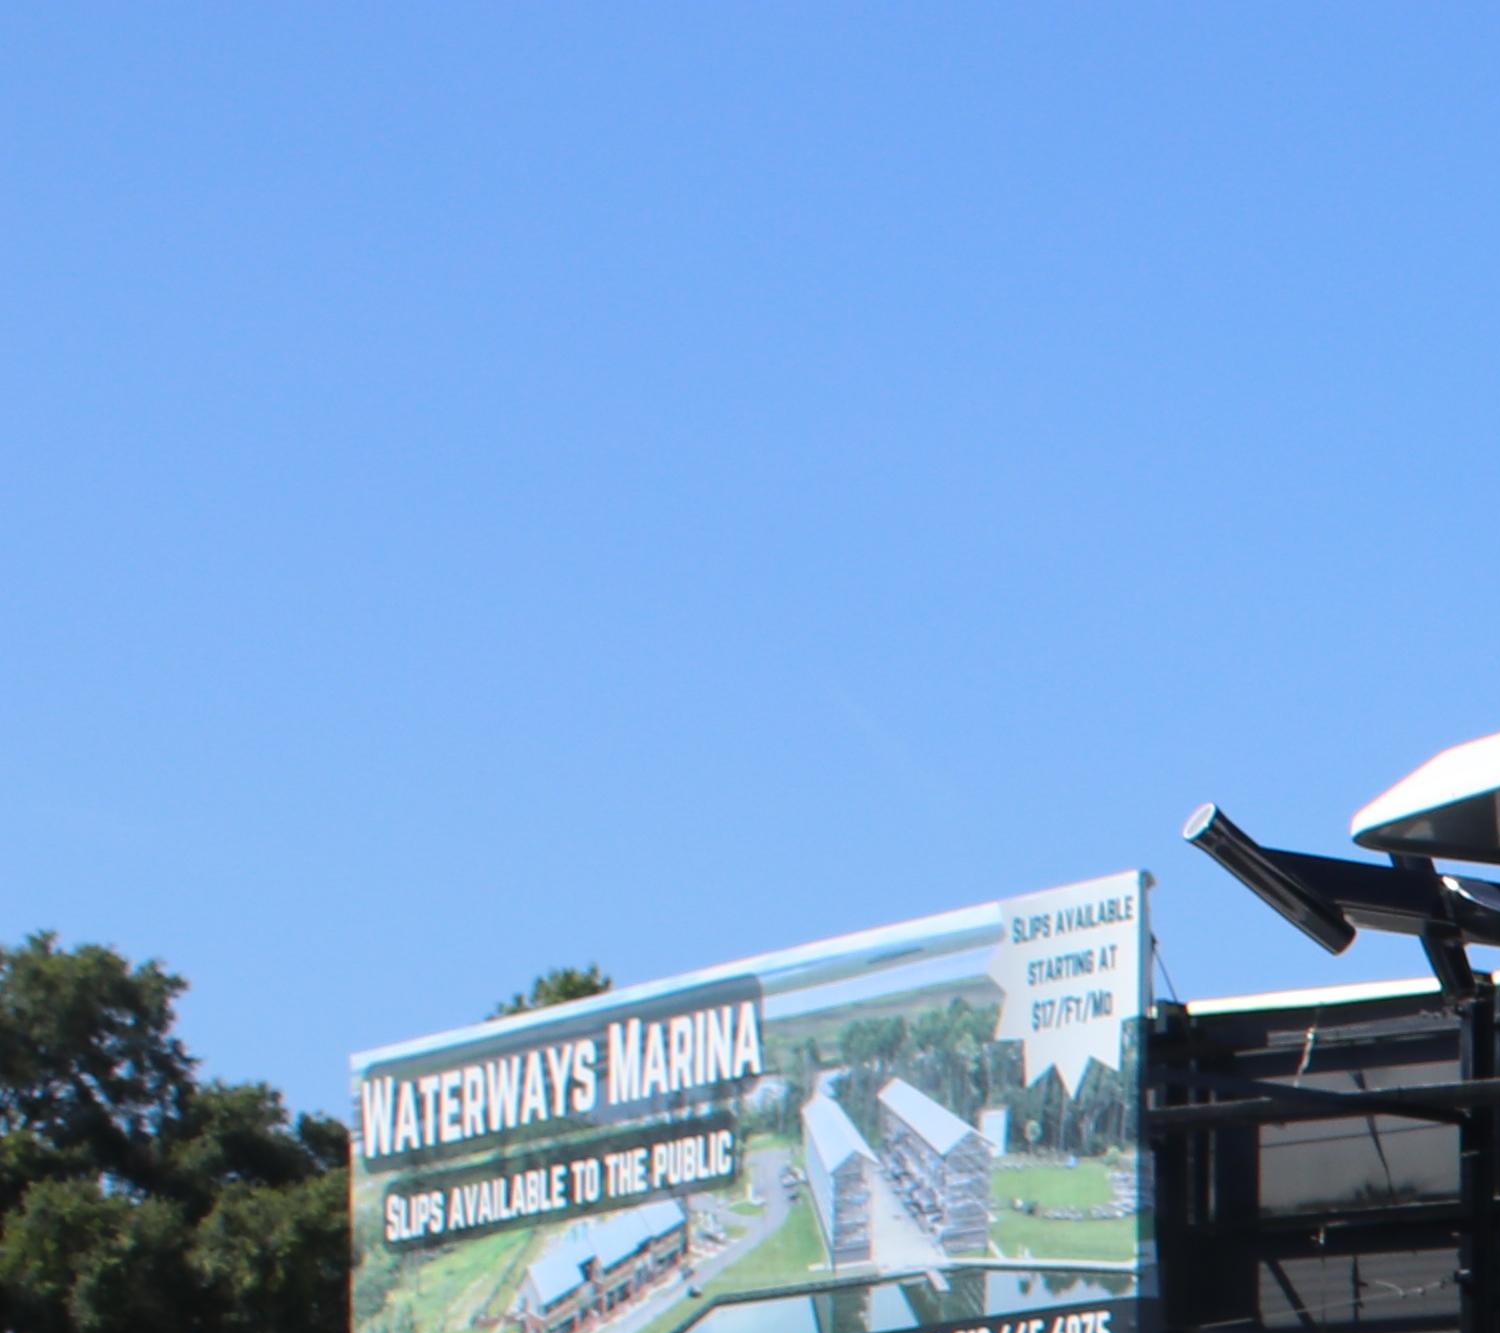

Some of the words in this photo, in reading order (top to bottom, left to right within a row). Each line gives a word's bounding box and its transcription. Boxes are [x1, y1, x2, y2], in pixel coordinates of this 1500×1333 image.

[1012, 912, 1051, 944] SLIPS
[1055, 895, 1134, 935] AVAILABLE
[1027, 949, 1094, 986] STARTING
[1099, 944, 1117, 969] AT
[362, 1039, 599, 1158] WATERWAYS
[608, 1002, 763, 1104] MARINA
[385, 1190, 444, 1242] SLIPS
[447, 1165, 567, 1230] AVAILABLE
[571, 1158, 599, 1205] TO
[604, 1147, 648, 1197] THE
[651, 1129, 735, 1188] PUBLIC
